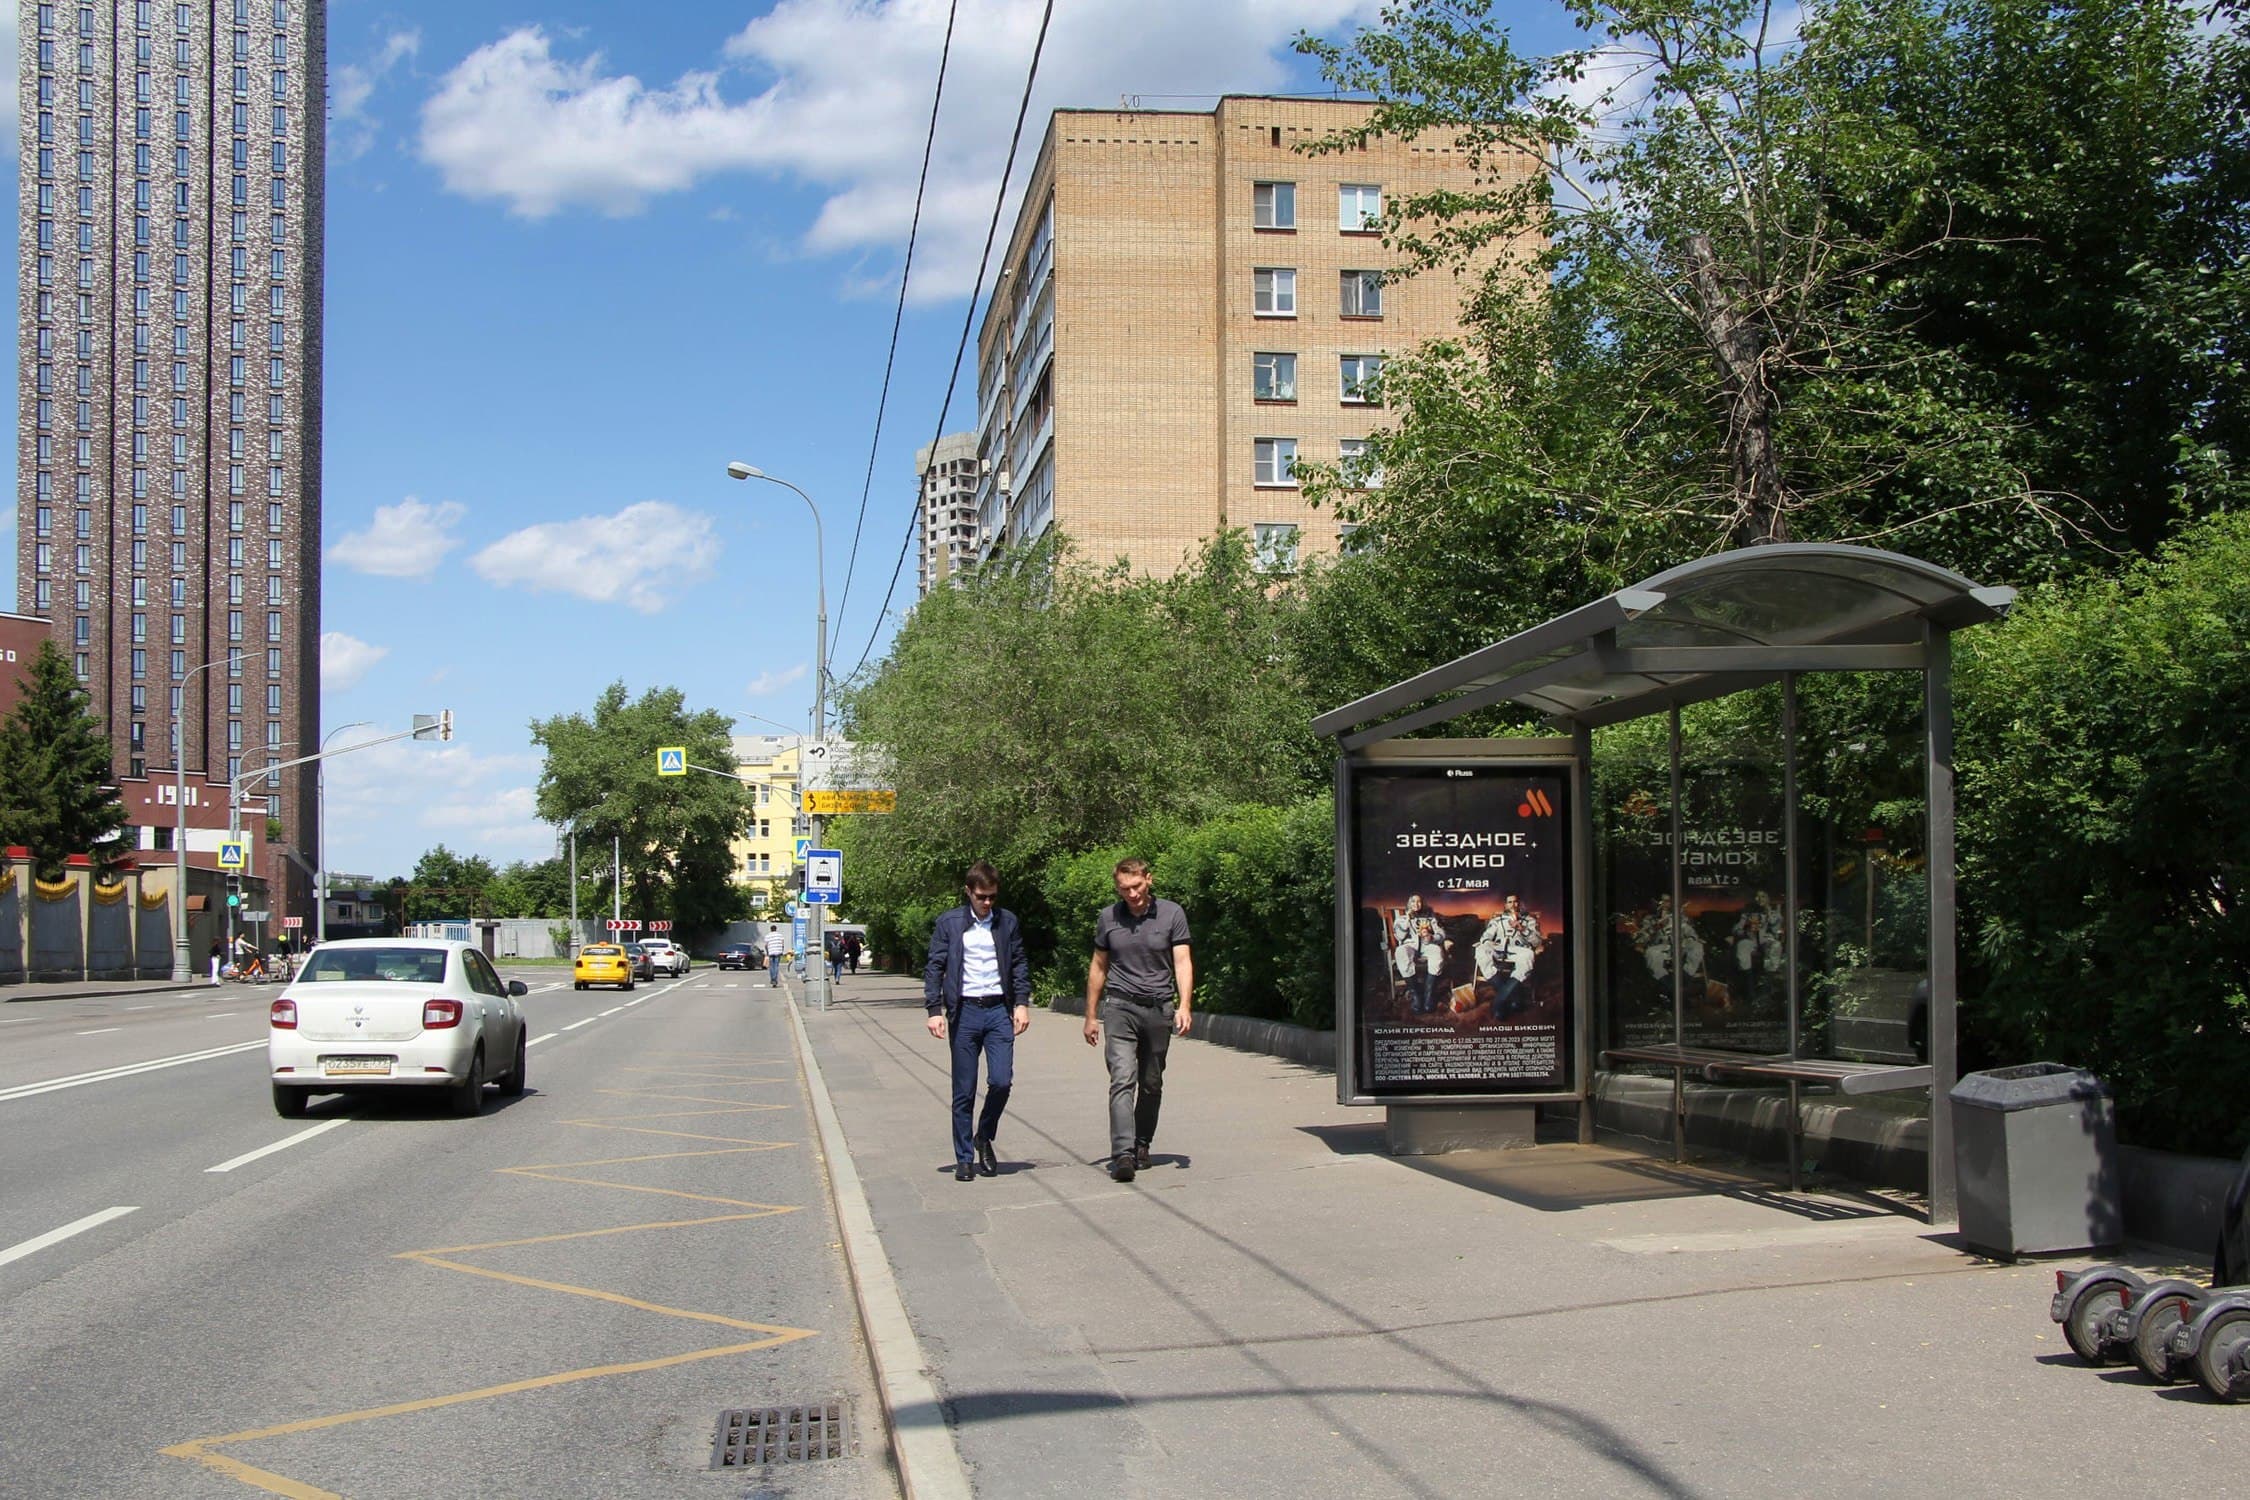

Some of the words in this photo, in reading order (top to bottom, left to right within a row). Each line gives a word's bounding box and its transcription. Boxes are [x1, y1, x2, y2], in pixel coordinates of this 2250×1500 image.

[1396, 830, 1526, 849] ЗВЁЗДНОЕ
[1418, 854, 1505, 869] КОМБО
[1437, 880, 1445, 888] с
[1447, 878, 1463, 888] 17
[1465, 880, 1489, 888] мая
